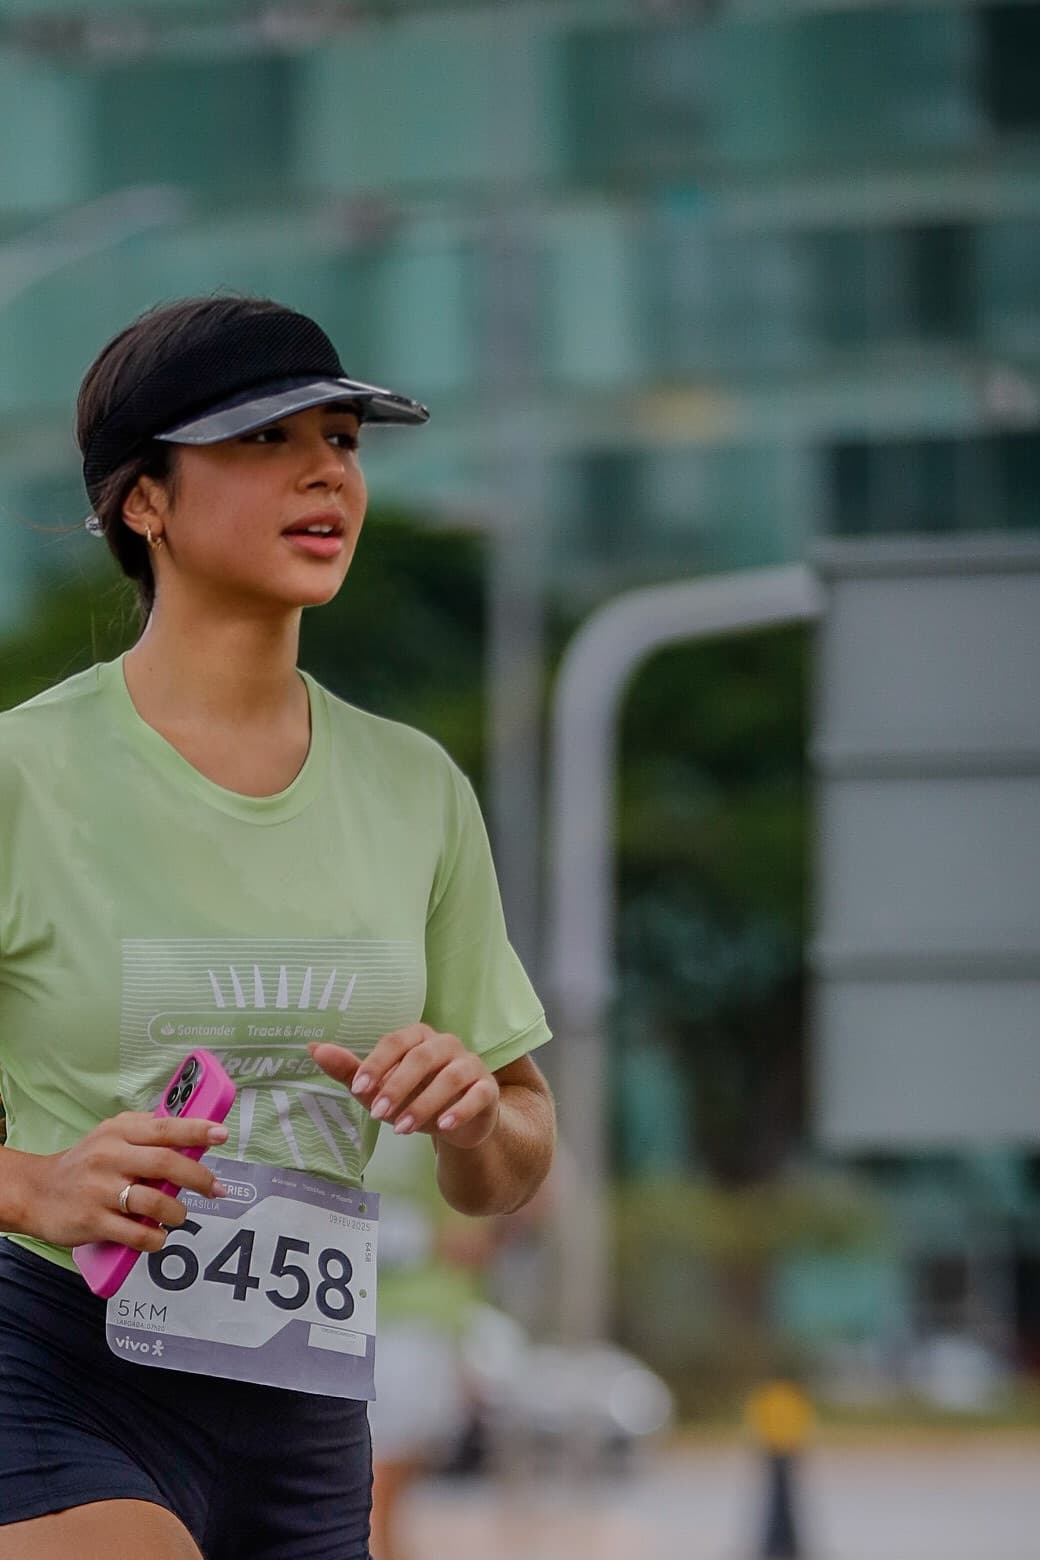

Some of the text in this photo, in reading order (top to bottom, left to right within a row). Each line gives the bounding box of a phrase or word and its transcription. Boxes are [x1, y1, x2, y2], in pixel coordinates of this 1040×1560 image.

[176, 1024, 236, 1037] Santander
[147, 1218, 355, 1321] 6458
[117, 1298, 168, 1323] 5KM
[115, 1335, 150, 1353] vivo
